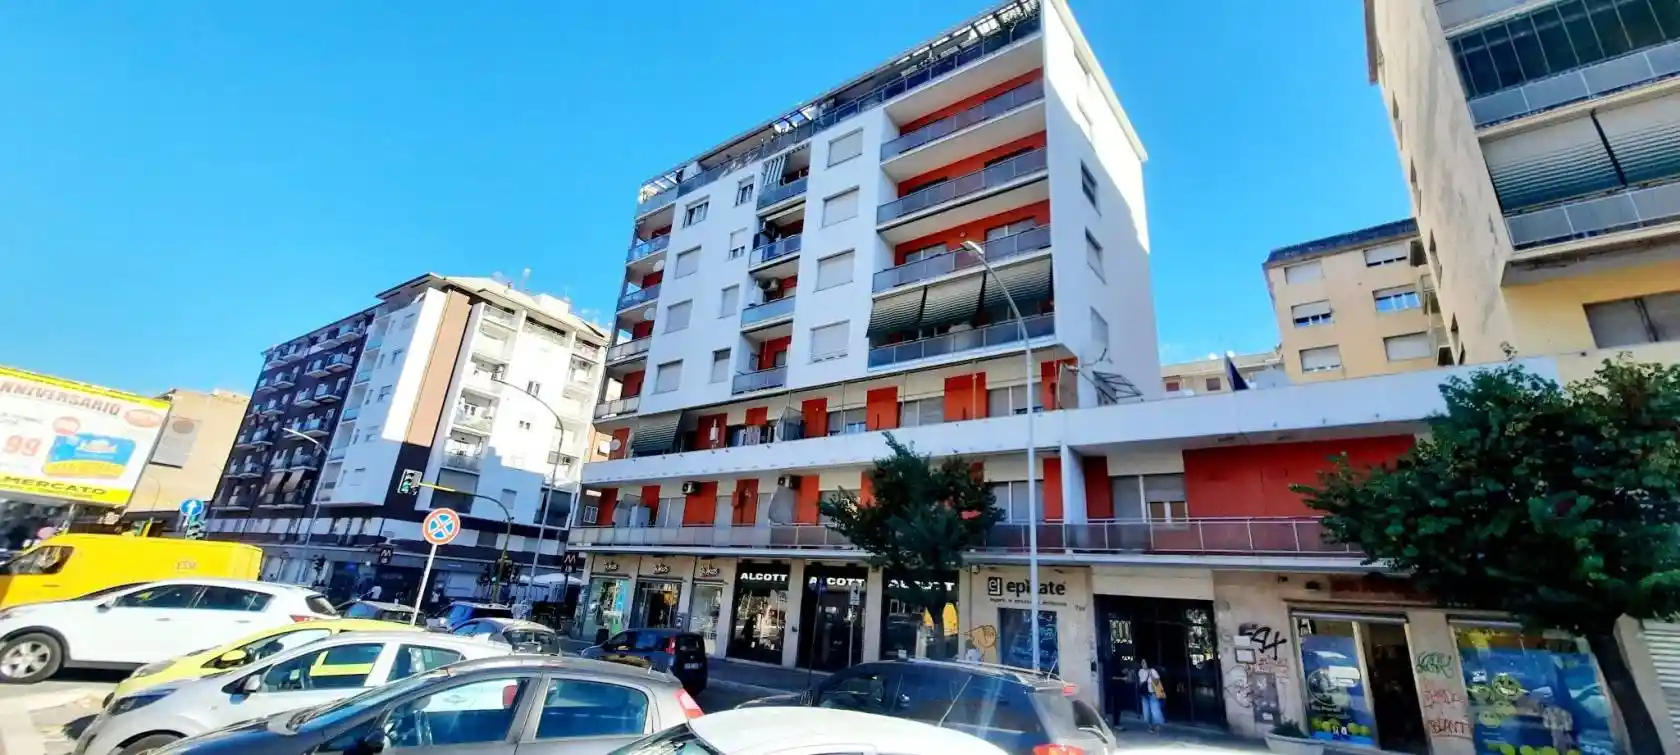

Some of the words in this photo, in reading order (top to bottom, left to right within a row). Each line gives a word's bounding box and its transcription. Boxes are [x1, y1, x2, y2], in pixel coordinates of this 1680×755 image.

[740, 572, 788, 582] ALCOTT
[808, 576, 865, 587] ACOTT
[1006, 579, 1066, 597] epiate
